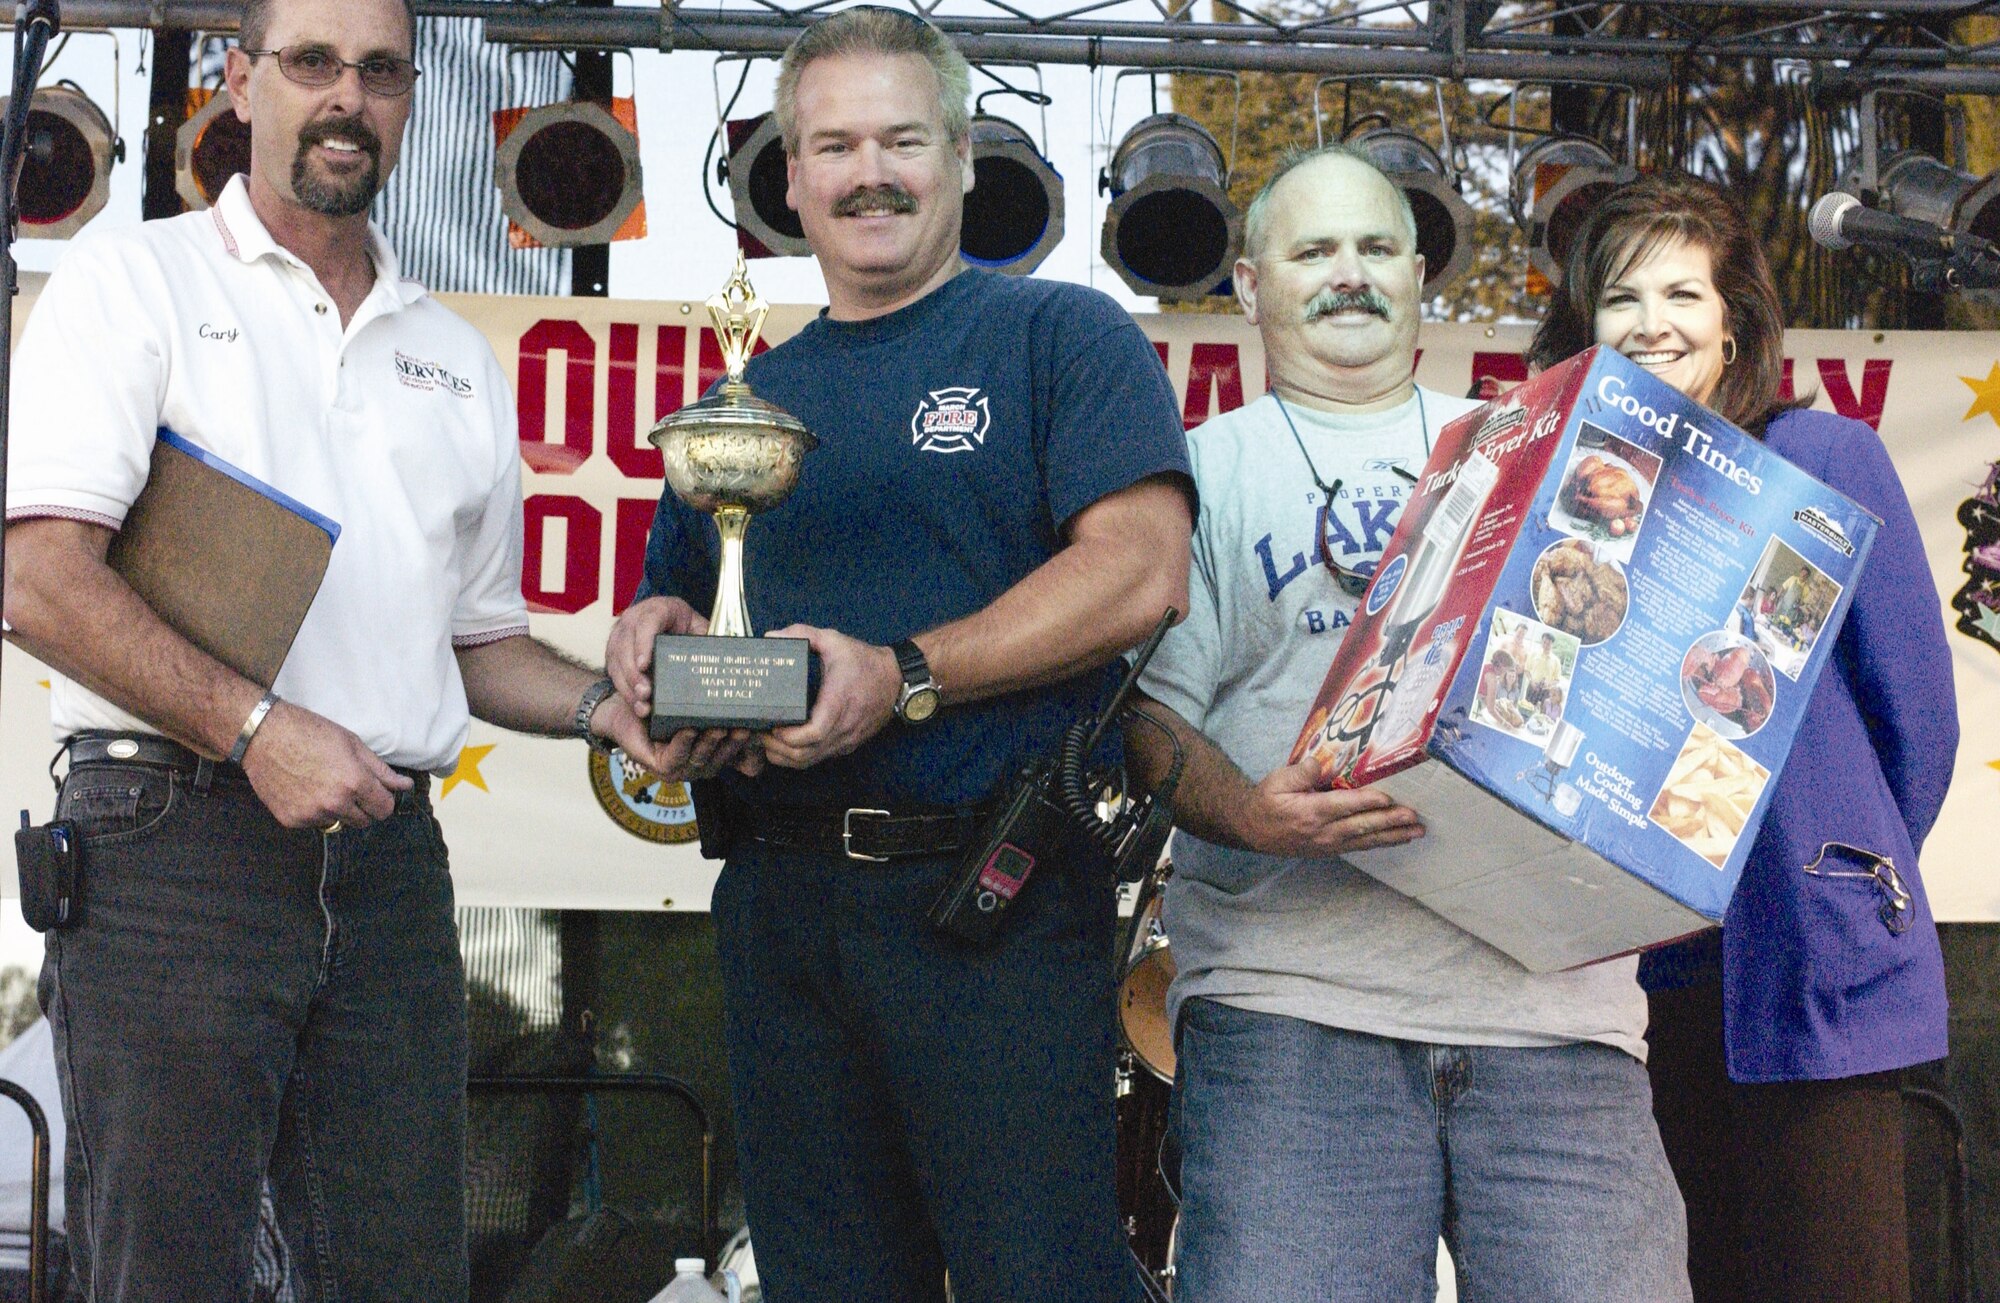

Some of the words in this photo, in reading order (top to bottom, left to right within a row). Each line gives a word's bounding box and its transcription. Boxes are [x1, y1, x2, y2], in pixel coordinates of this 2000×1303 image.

[199, 323, 239, 343] Cary
[395, 357, 472, 392] SERVICES
[923, 410, 978, 427] FIRE
[924, 425, 975, 433] DEPARTMENT
[1598, 375, 1679, 439] Good
[1682, 422, 1763, 496] Times
[1421, 459, 1461, 497] Turk
[1485, 430, 1529, 466] Fryer
[1529, 411, 1561, 443] Kit
[1306, 485, 1415, 504] POPER
[1709, 501, 1735, 525] Fryer
[1738, 521, 1755, 537] Kit
[1800, 513, 1848, 549] MASTERBUILT
[1254, 499, 1402, 602] LAK
[1305, 608, 1357, 634] BA
[691, 655, 720, 664] AUTUMN
[754, 657, 770, 666] CAR
[772, 657, 796, 667] SHOW
[701, 678, 737, 687] MARCH
[742, 679, 762, 689] ARB
[724, 689, 754, 699] PLACE
[1586, 752, 1635, 790] Outdoor
[1575, 774, 1609, 802] Made
[1608, 798, 1648, 829] Simple
[1594, 770, 1643, 810] Cooking
[656, 808, 687, 818] 1775
